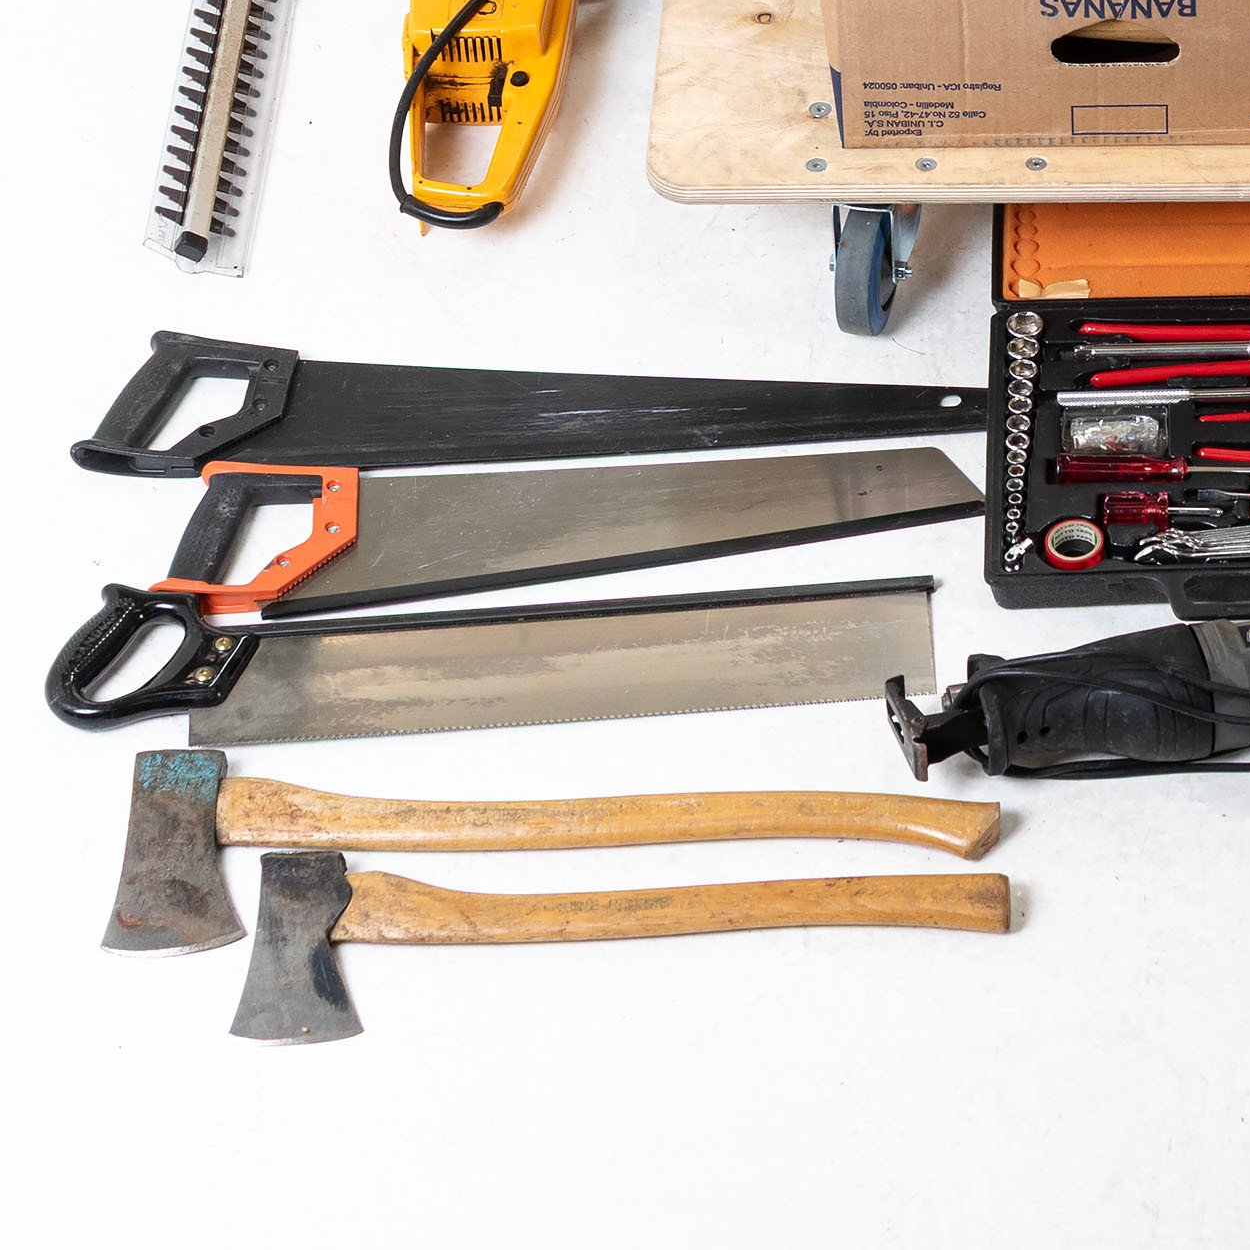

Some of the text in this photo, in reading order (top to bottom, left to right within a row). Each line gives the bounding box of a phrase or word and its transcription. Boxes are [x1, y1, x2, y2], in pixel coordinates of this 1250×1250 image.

[863, 82, 1002, 92] Registro ICA Uniban: 050024
[863, 101, 907, 109] Colombia
[916, 101, 954, 109] Medellin
[864, 110, 987, 119] Calle 52 No.47-42, Piso 15
[864, 120, 884, 128] S.A.
[886, 120, 925, 128] UNIBAN
[864, 128, 922, 137] Exported by:
